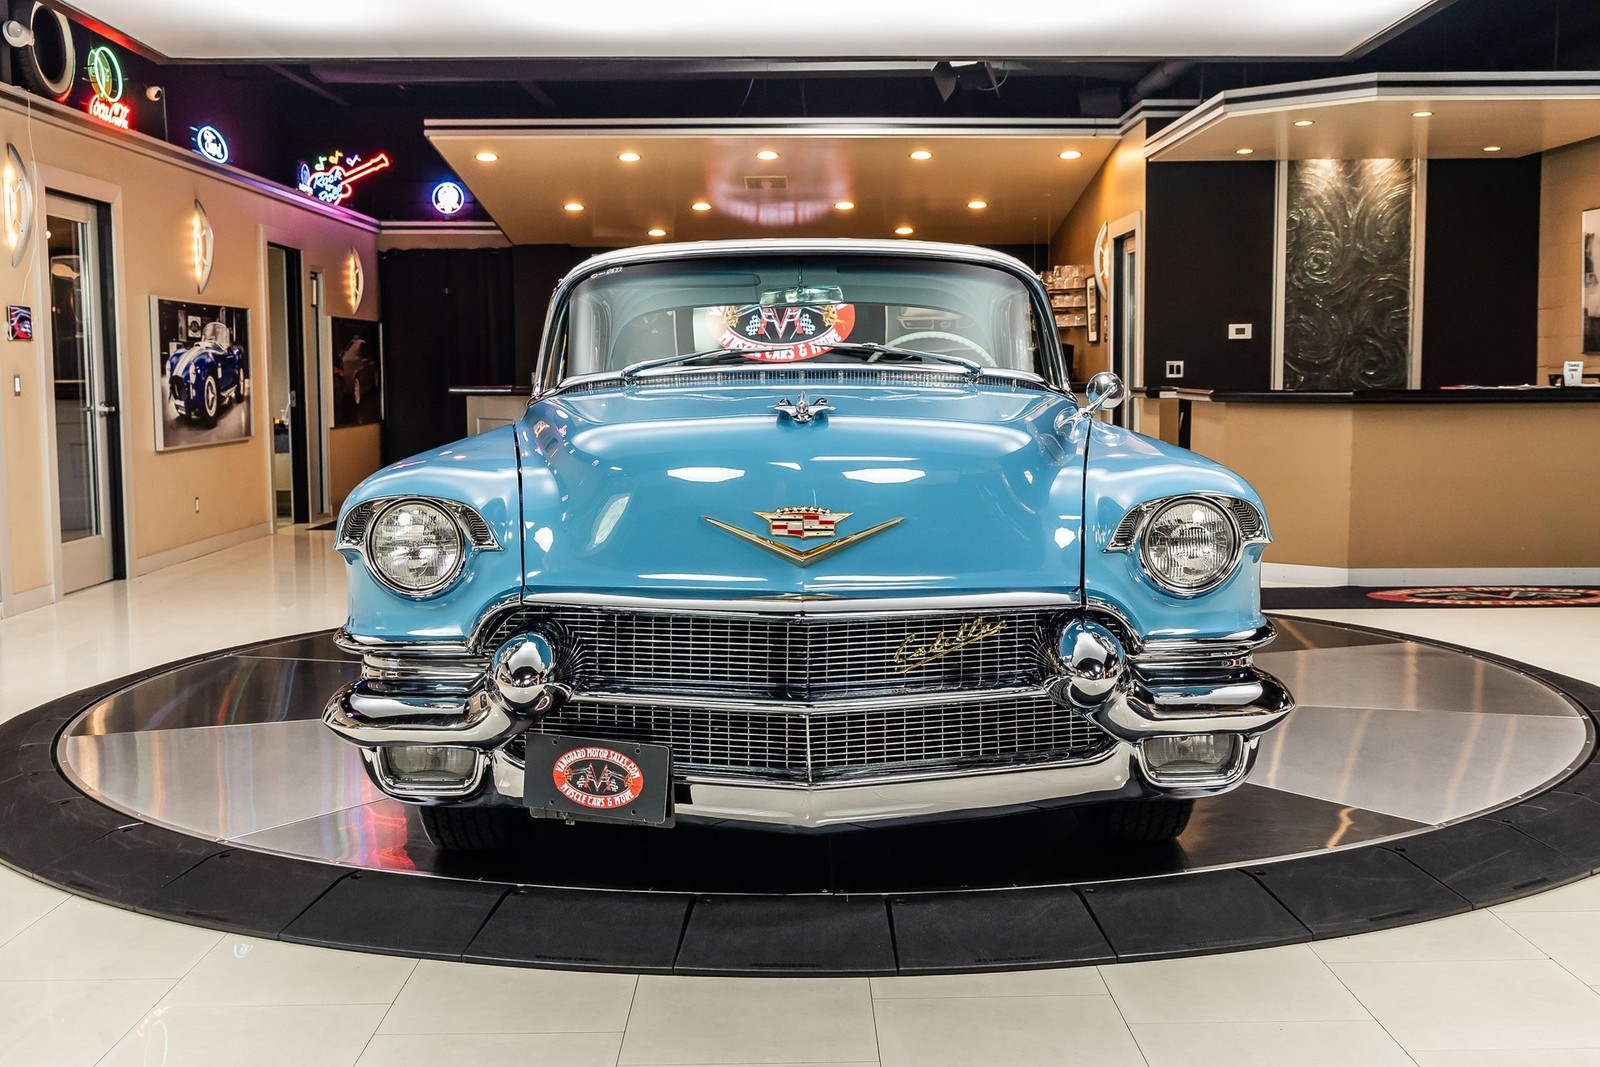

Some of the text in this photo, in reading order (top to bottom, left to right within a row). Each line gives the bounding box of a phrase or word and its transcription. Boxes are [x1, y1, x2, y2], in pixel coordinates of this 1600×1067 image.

[313, 168, 343, 189] Rock
[893, 617, 1006, 664] Cadillac
[555, 749, 586, 773] VANGUARD
[586, 748, 609, 759] MOTOR
[559, 783, 635, 807] MUSCLE CARS & MORE
